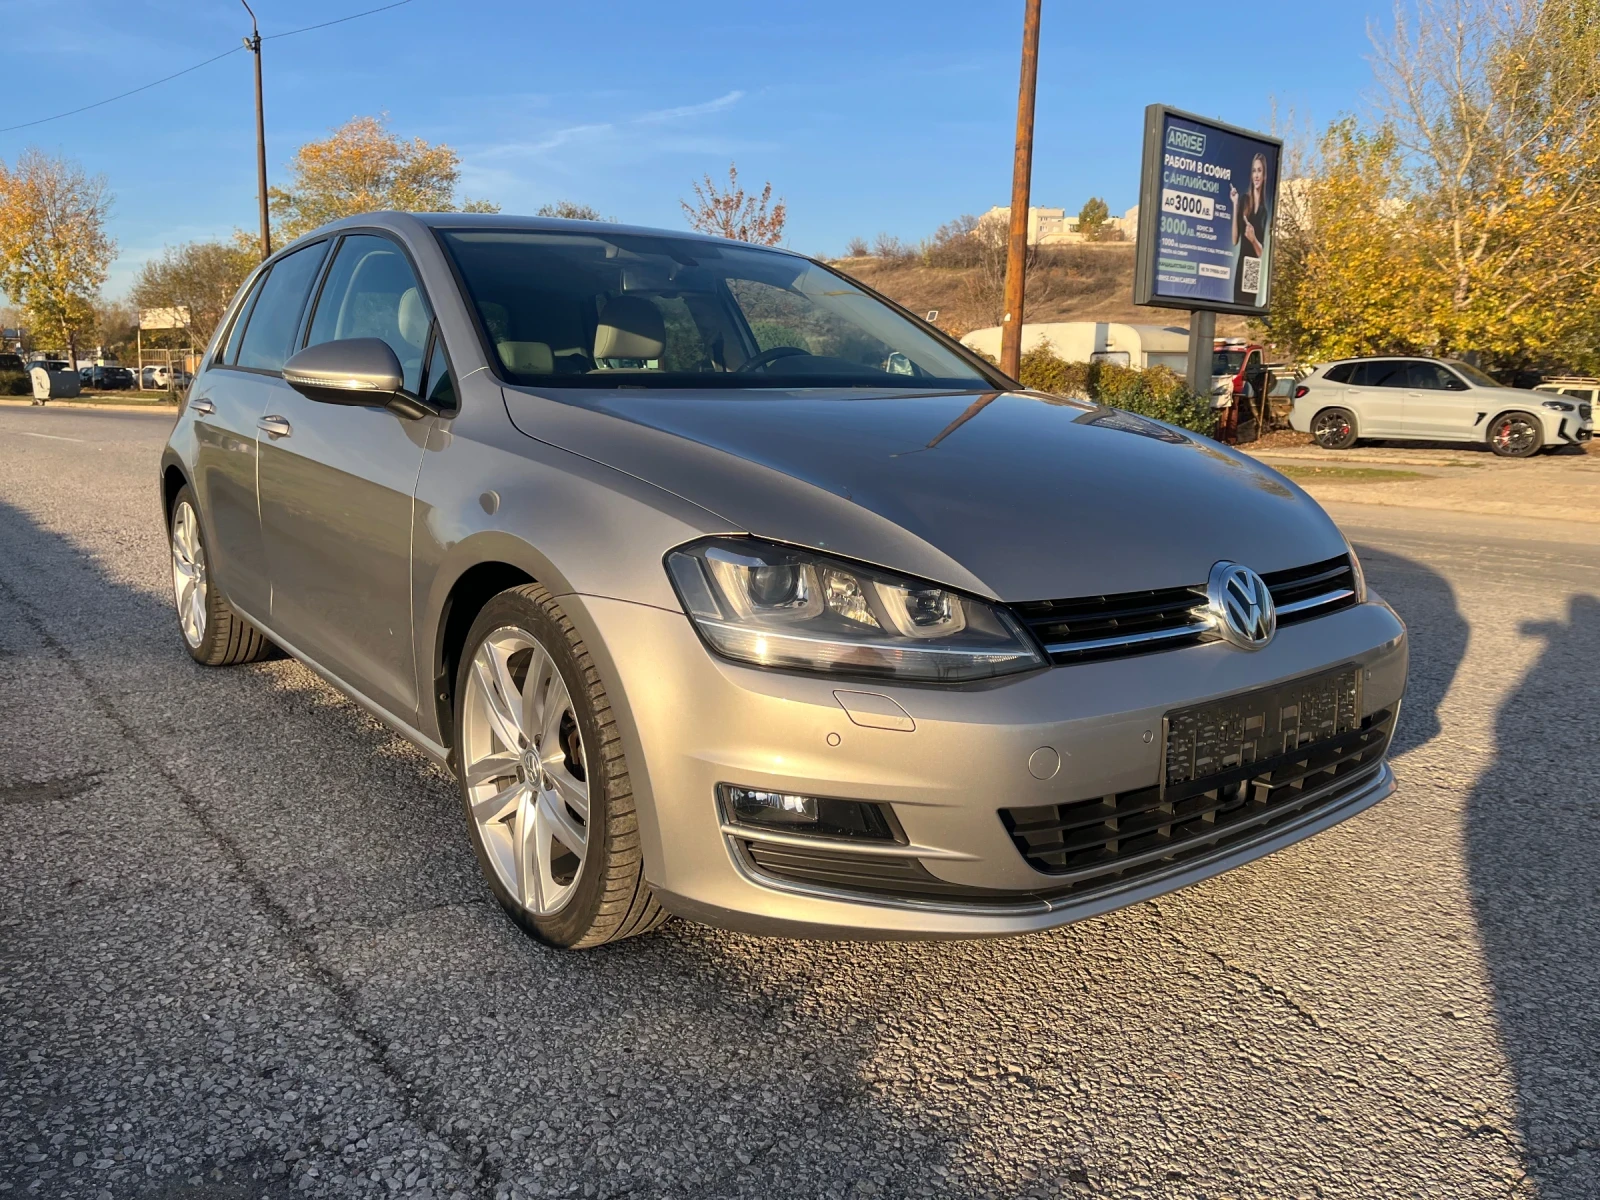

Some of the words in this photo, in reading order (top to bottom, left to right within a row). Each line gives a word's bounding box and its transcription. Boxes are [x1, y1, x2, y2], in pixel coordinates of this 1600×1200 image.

[1168, 131, 1203, 151] ARRISE
[1164, 154, 1196, 172] РАБОТИ
[1197, 162, 1202, 173] В
[1204, 163, 1231, 180] СОФИЯ
[1163, 171, 1169, 182] С
[1170, 174, 1220, 193] АНГЛИЙСКИ!
[1165, 197, 1174, 206] ДО
[1175, 194, 1202, 214] 3000
[1161, 216, 1187, 235] 3000
[1162, 237, 1174, 246] 1000
